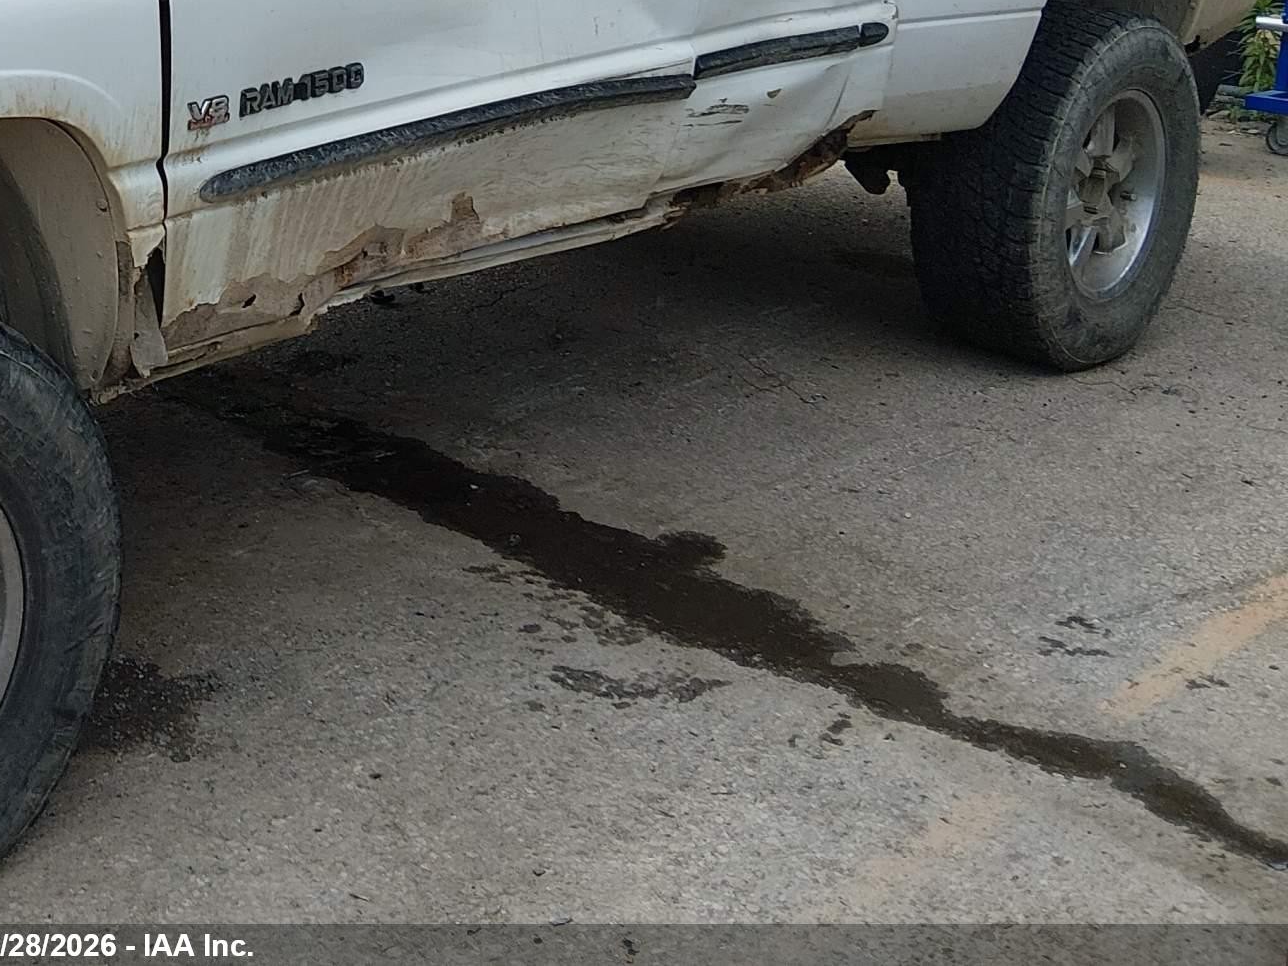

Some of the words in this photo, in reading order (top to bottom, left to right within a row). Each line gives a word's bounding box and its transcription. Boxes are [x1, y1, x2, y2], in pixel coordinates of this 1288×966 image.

[187, 95, 230, 124] V8
[240, 77, 295, 118] RAM
[301, 62, 365, 101] 1500
